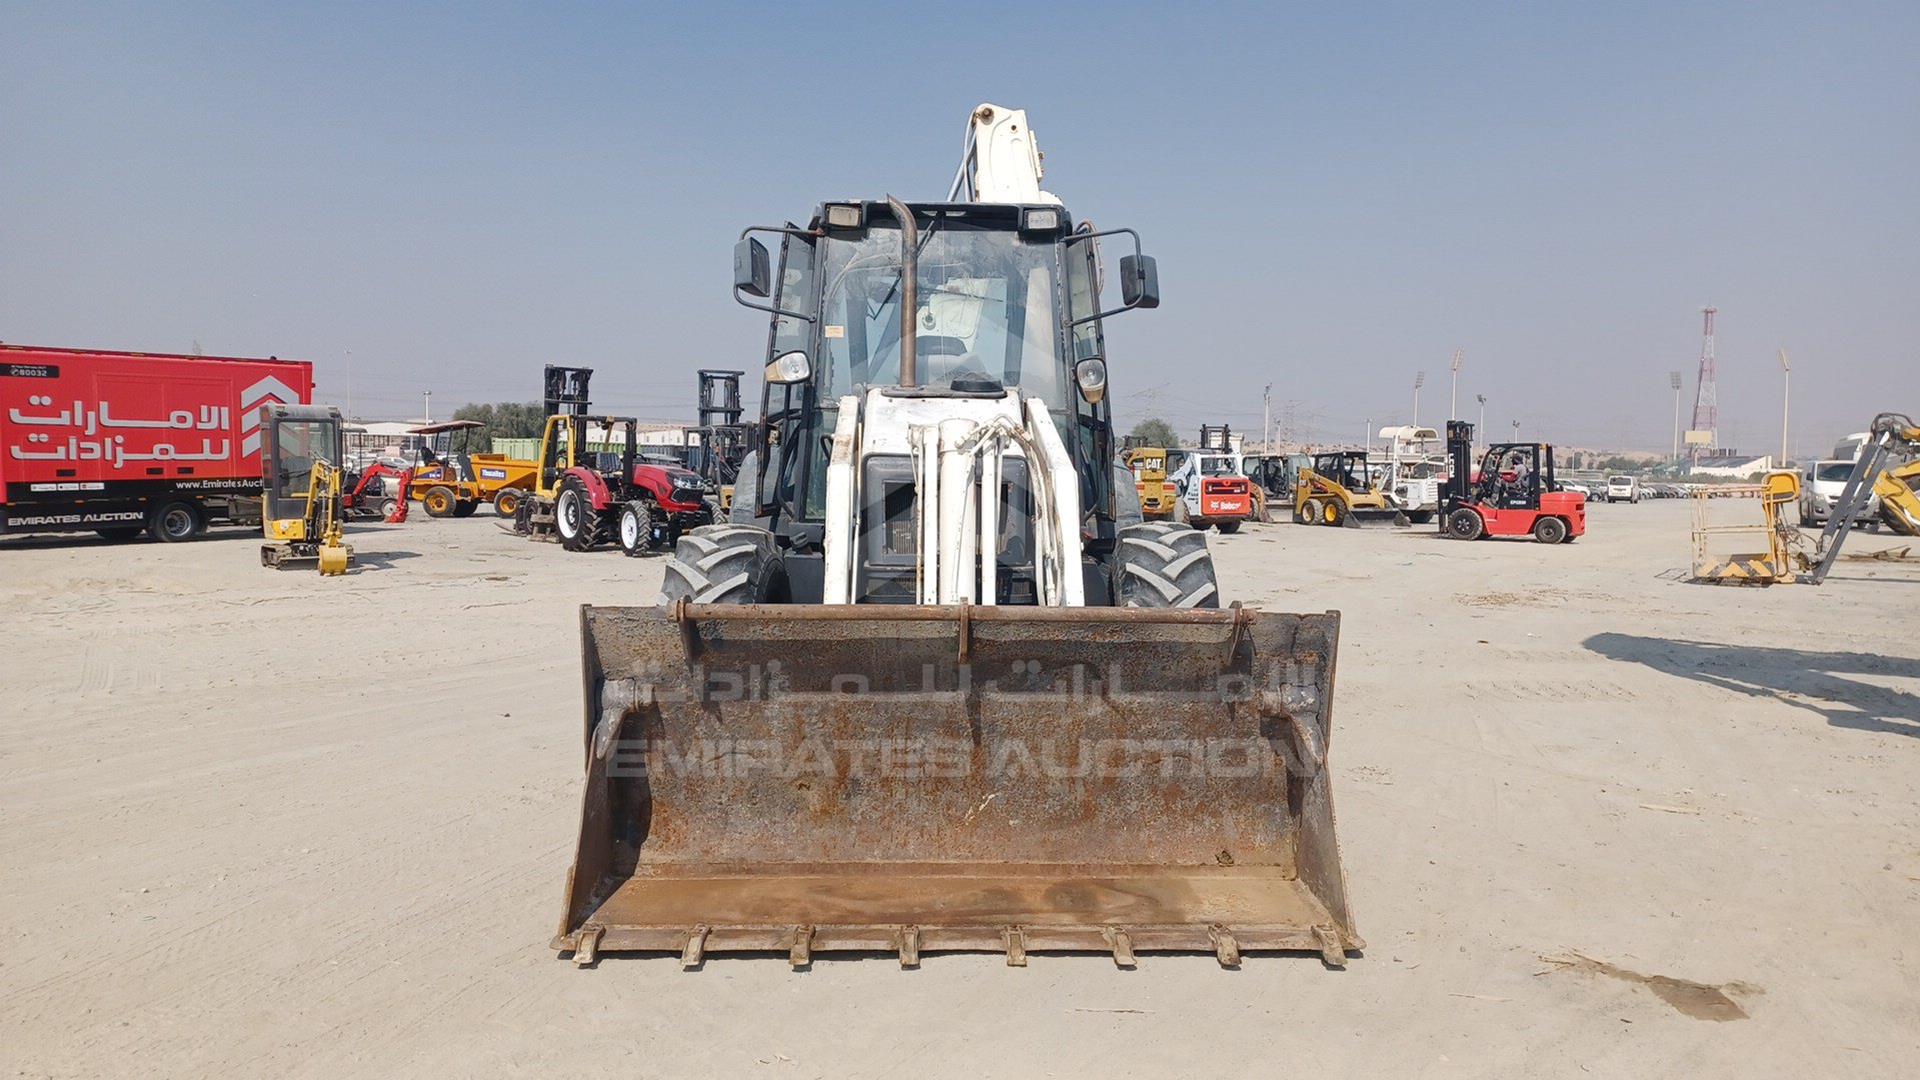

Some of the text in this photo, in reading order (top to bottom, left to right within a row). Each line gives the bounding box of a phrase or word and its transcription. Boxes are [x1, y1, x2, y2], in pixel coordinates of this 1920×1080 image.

[9, 395, 230, 436] الامارات
[10, 433, 230, 469] للمزادات
[1146, 458, 1162, 470] CAT
[8, 511, 144, 526] EMIRATES AUCTION
